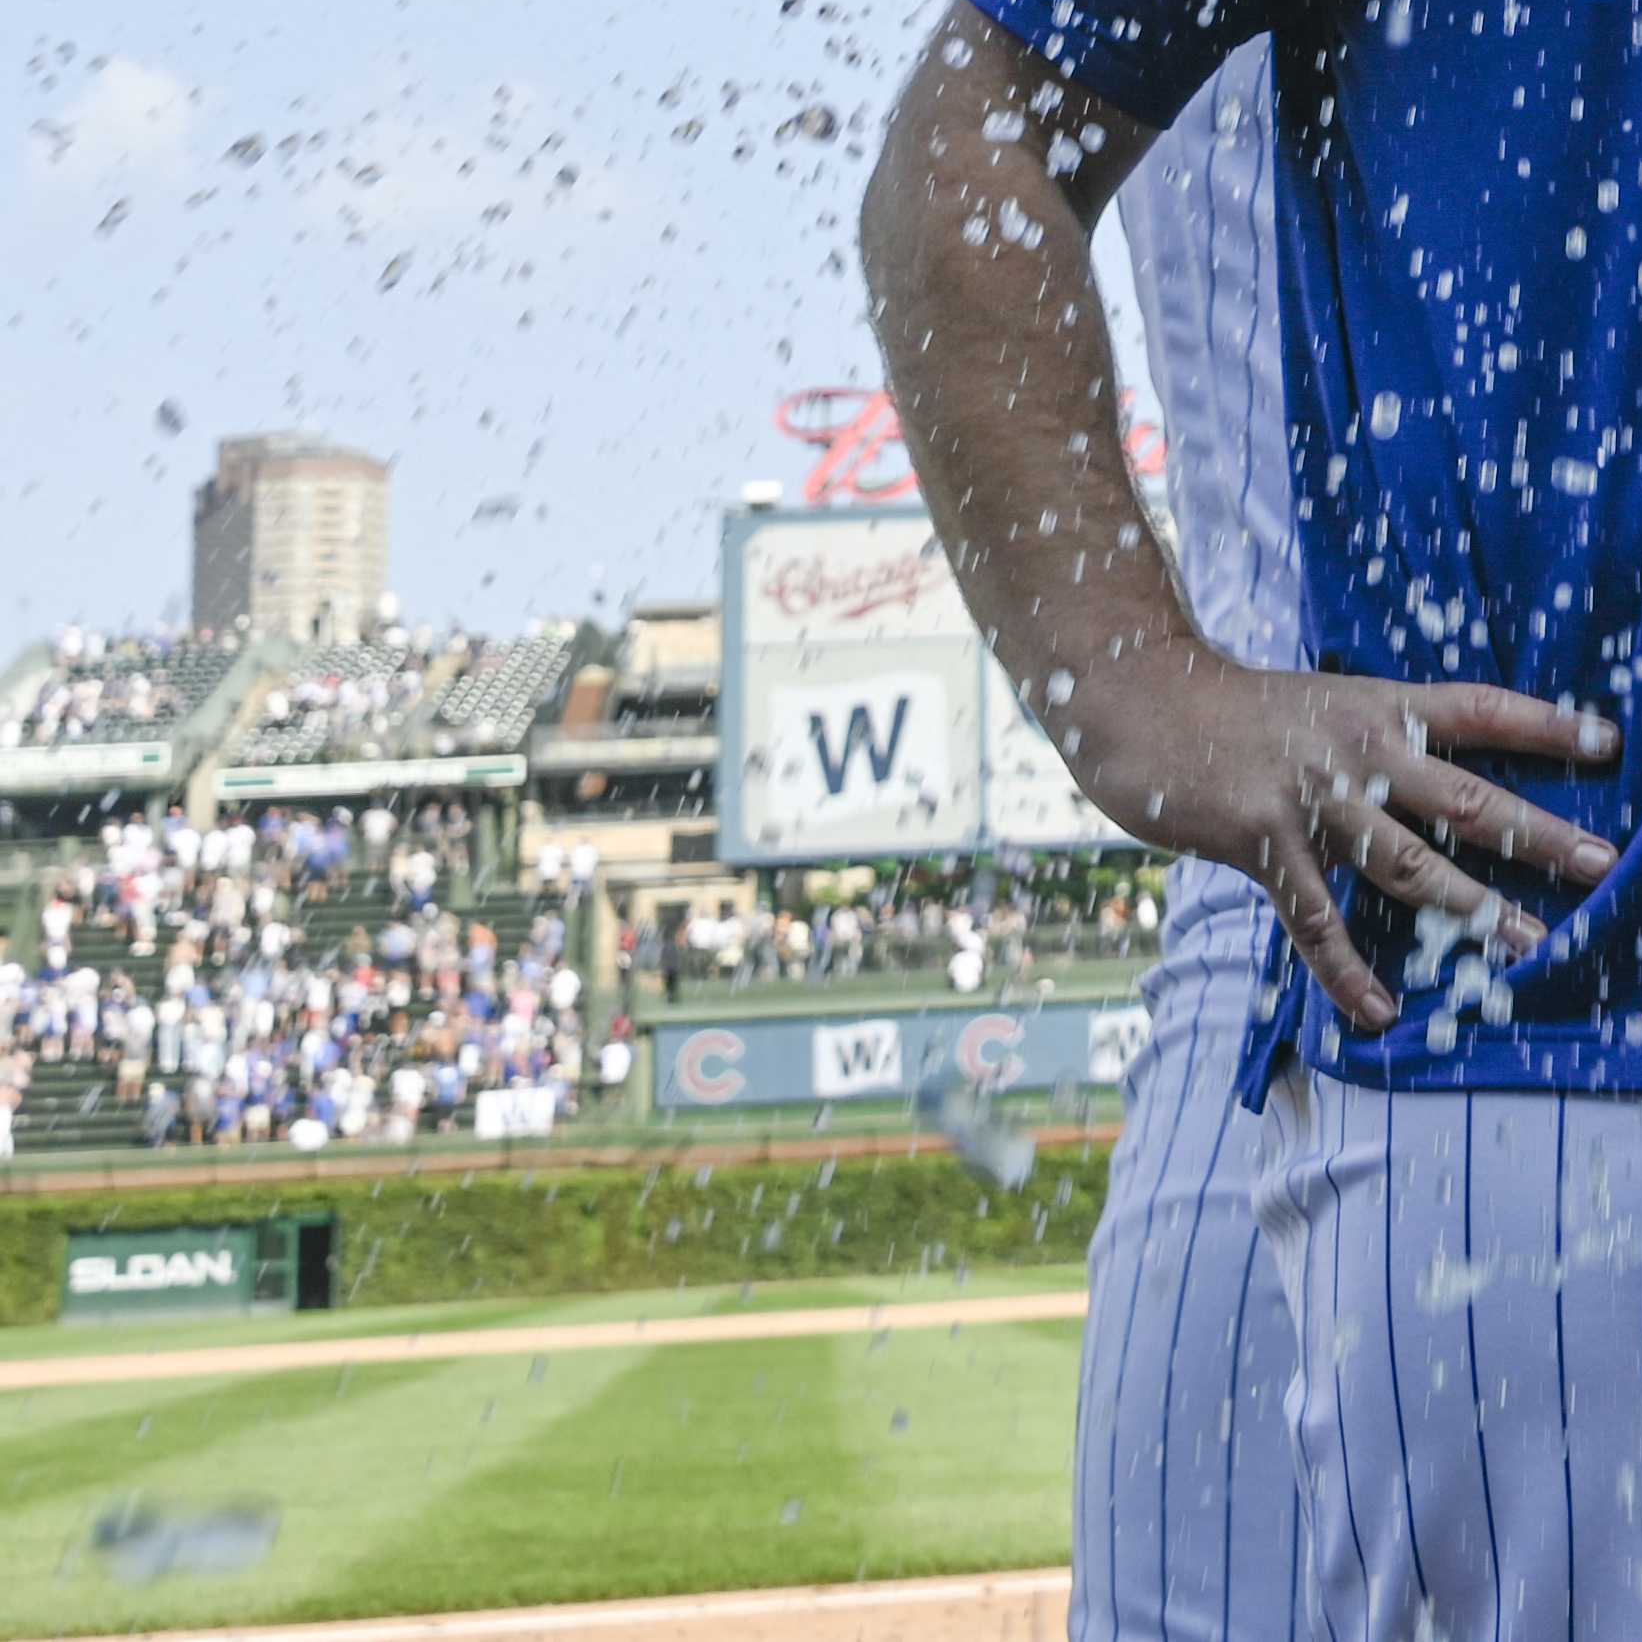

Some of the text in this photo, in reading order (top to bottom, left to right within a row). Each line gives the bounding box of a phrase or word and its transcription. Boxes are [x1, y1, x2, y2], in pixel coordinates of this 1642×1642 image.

[809, 694, 910, 795] W
[677, 1028, 746, 1105] C
[955, 1013, 1026, 1084] C
[68, 1249, 234, 1294] SLOAN
